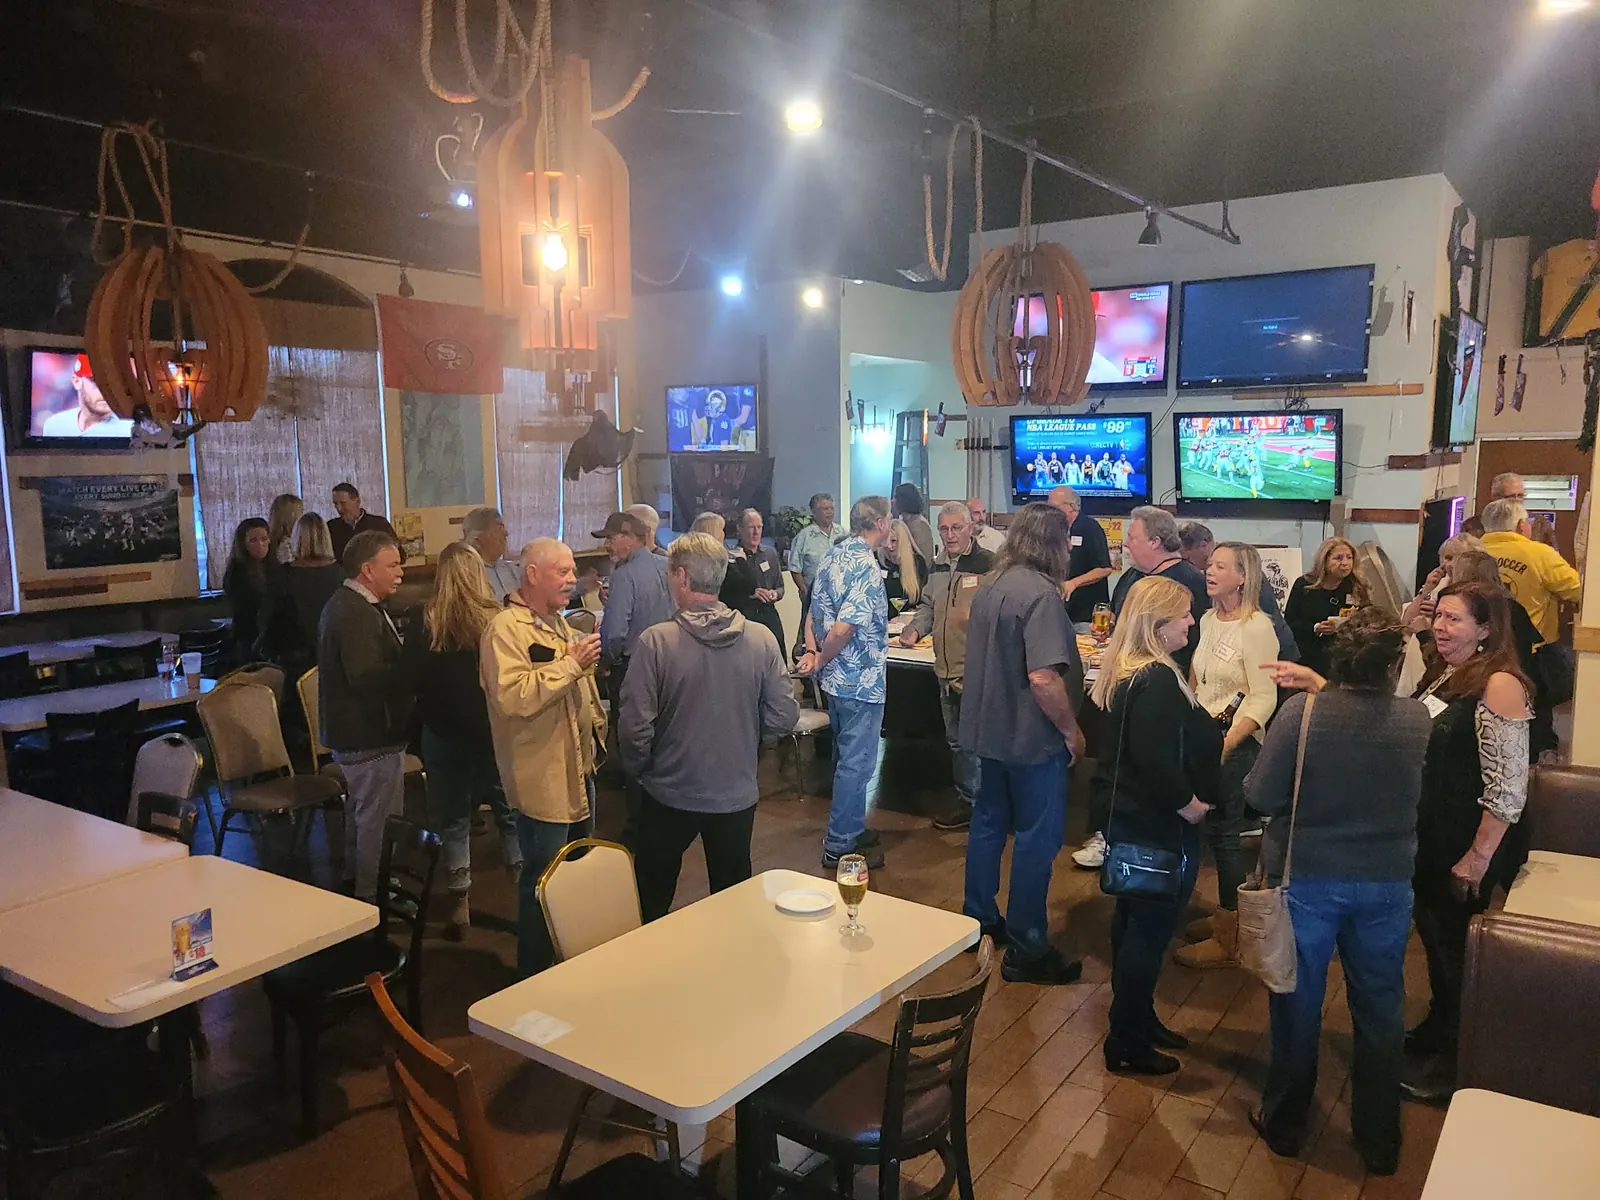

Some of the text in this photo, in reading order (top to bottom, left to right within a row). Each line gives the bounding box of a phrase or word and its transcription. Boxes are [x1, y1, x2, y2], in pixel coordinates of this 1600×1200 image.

[1026, 422, 1097, 432] NBA LEAGUE PASS
[90, 485, 118, 493] EVERY
[121, 485, 140, 493] LIVE
[1497, 557, 1527, 574] OCCER
